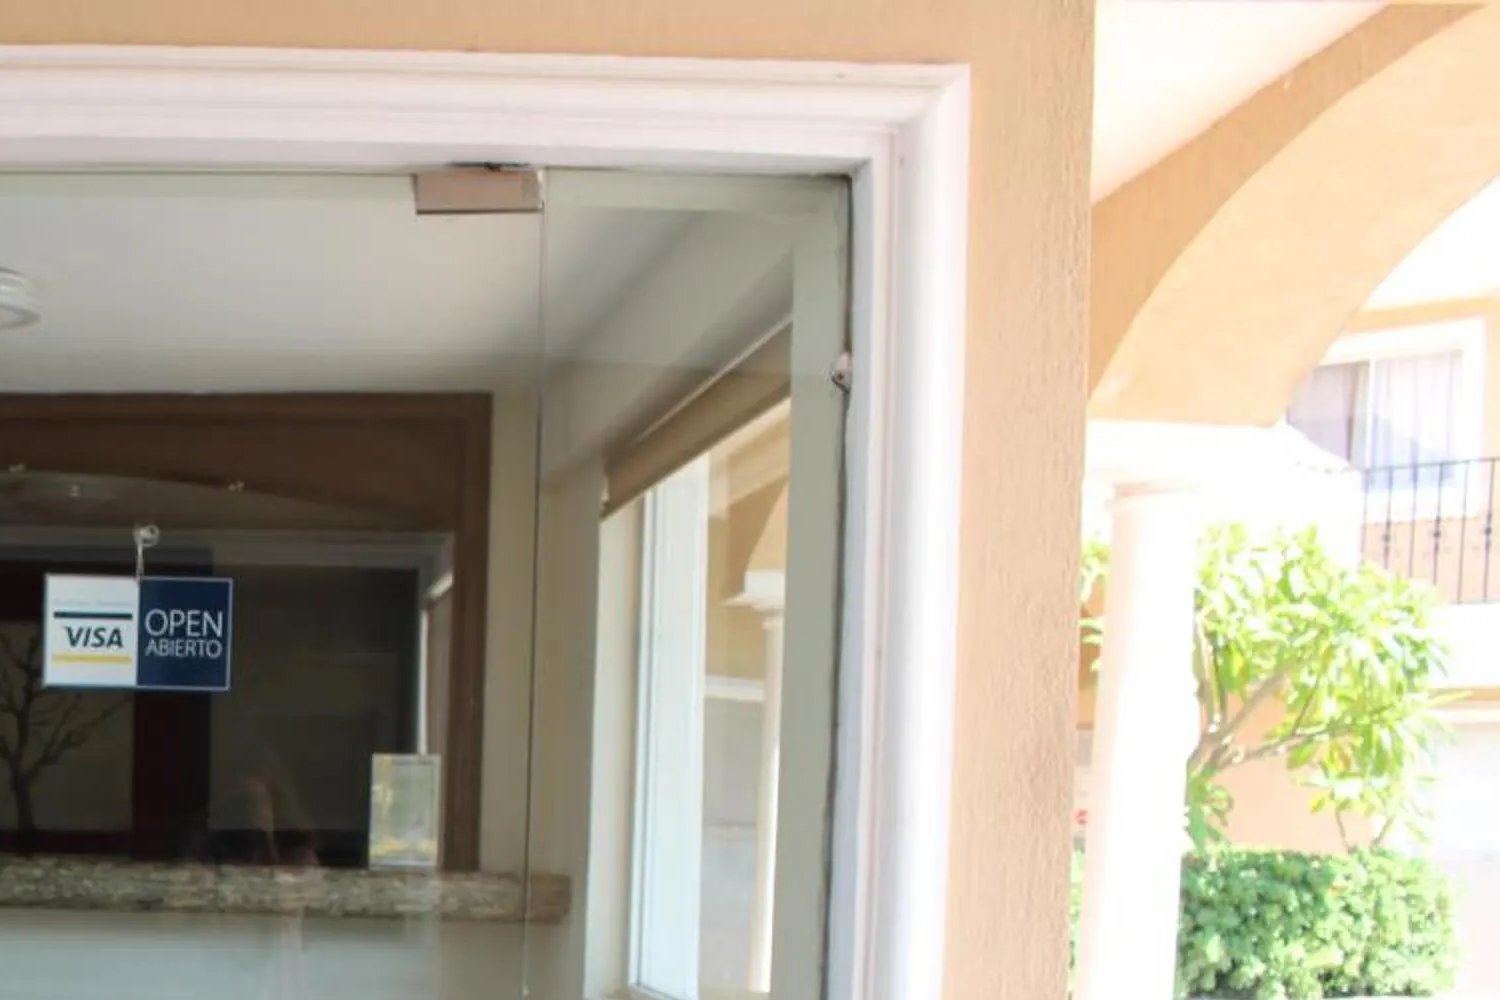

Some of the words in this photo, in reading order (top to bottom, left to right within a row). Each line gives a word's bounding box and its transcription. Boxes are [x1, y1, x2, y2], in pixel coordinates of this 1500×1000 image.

[144, 608, 223, 638] OPEN
[64, 625, 125, 649] VISA
[145, 639, 222, 659] ABIERTO
